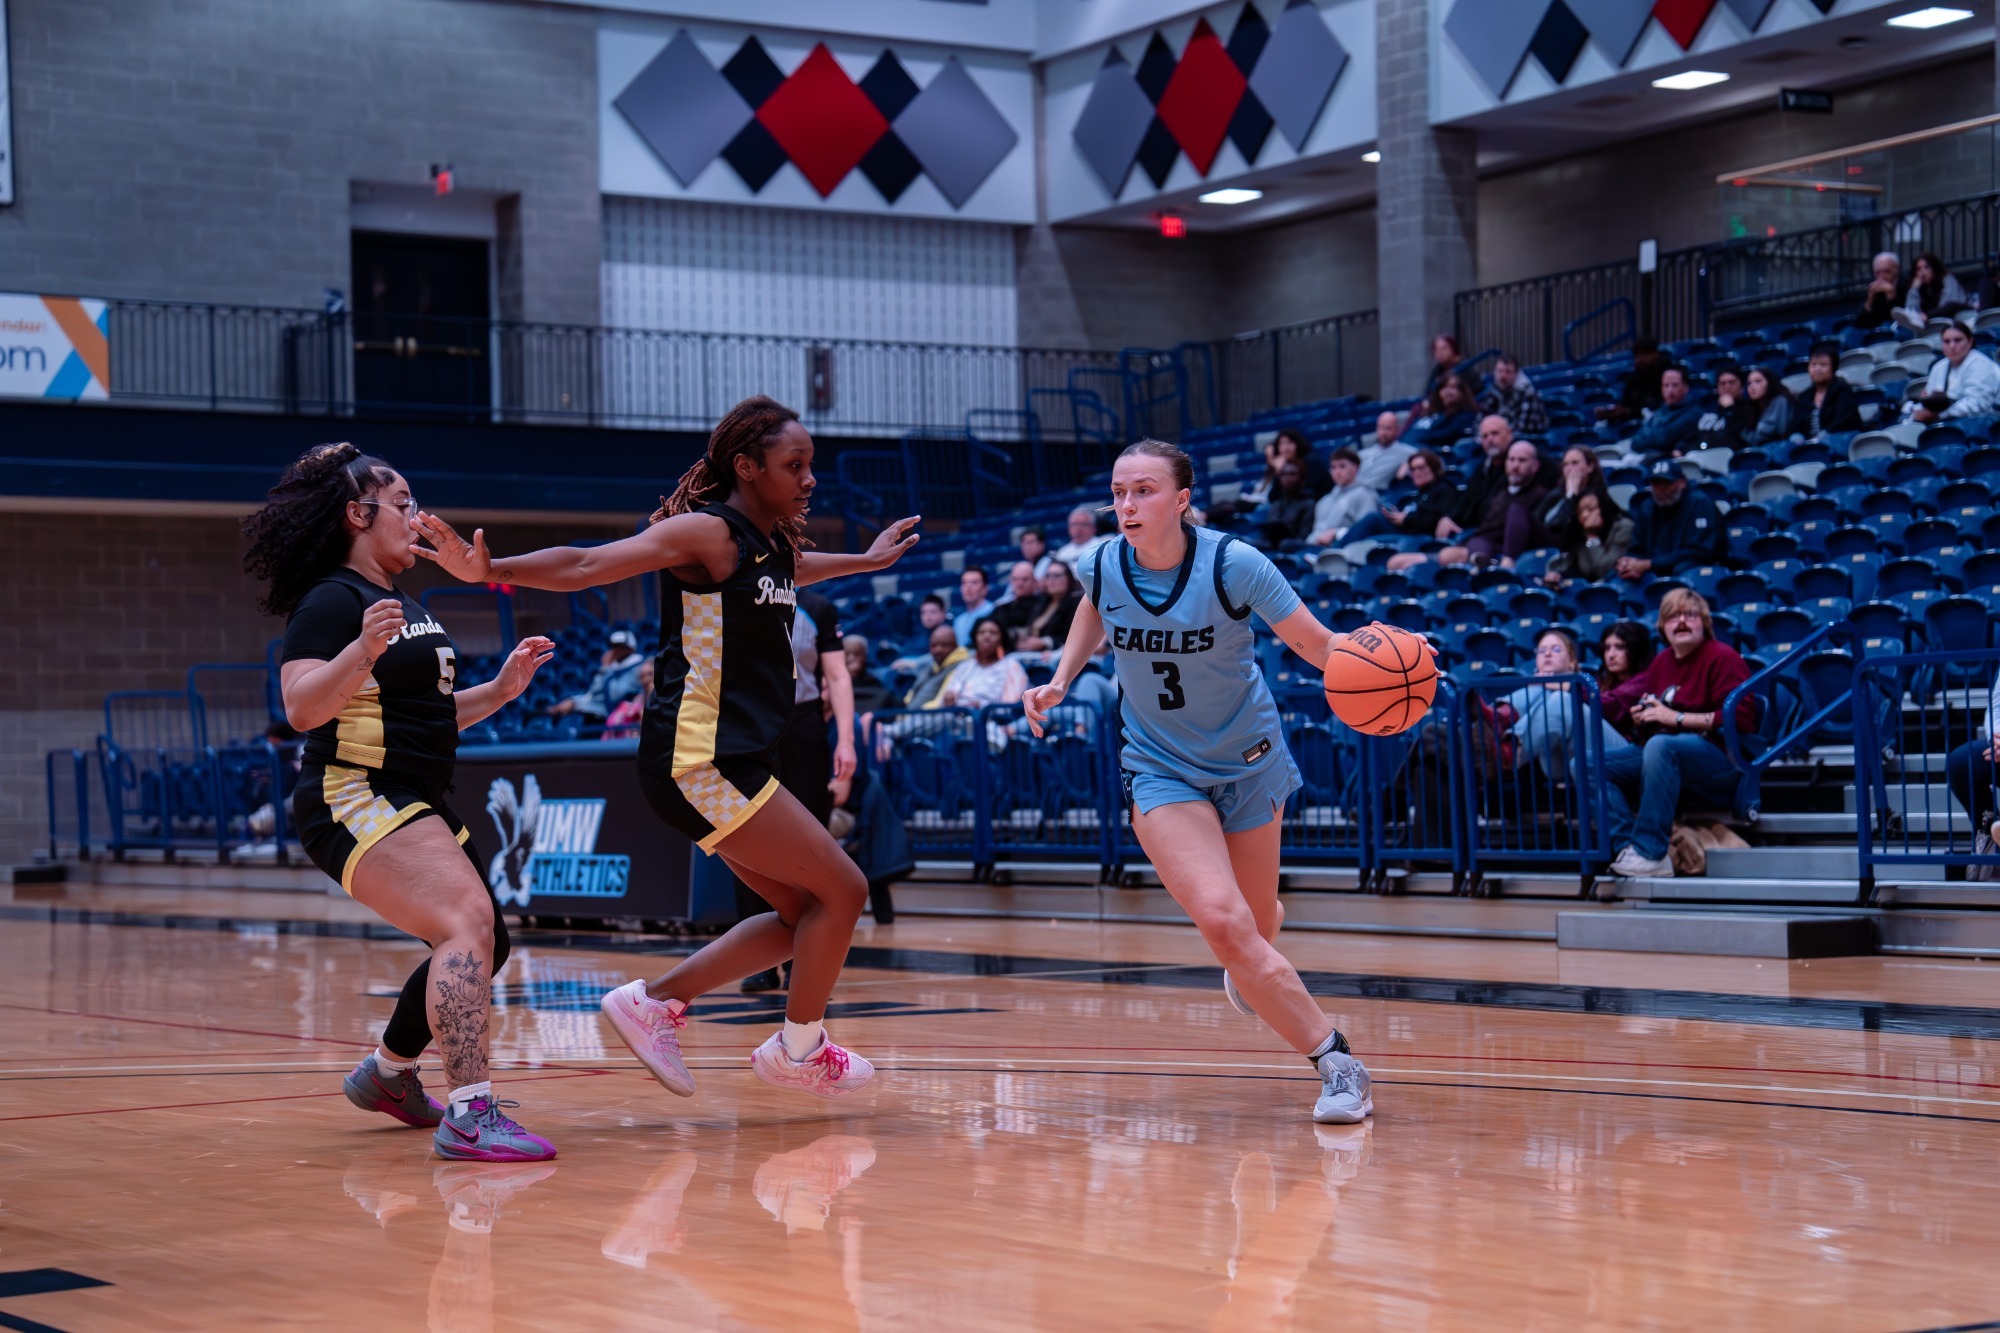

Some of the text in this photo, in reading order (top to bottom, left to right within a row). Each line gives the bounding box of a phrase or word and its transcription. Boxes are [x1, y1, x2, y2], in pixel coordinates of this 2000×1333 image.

[1113, 625, 1215, 654] EAGLES
[435, 646, 456, 695] 5
[1151, 661, 1186, 710] 3
[532, 803, 602, 854] UMW
[532, 857, 627, 892] ATHLETICS
